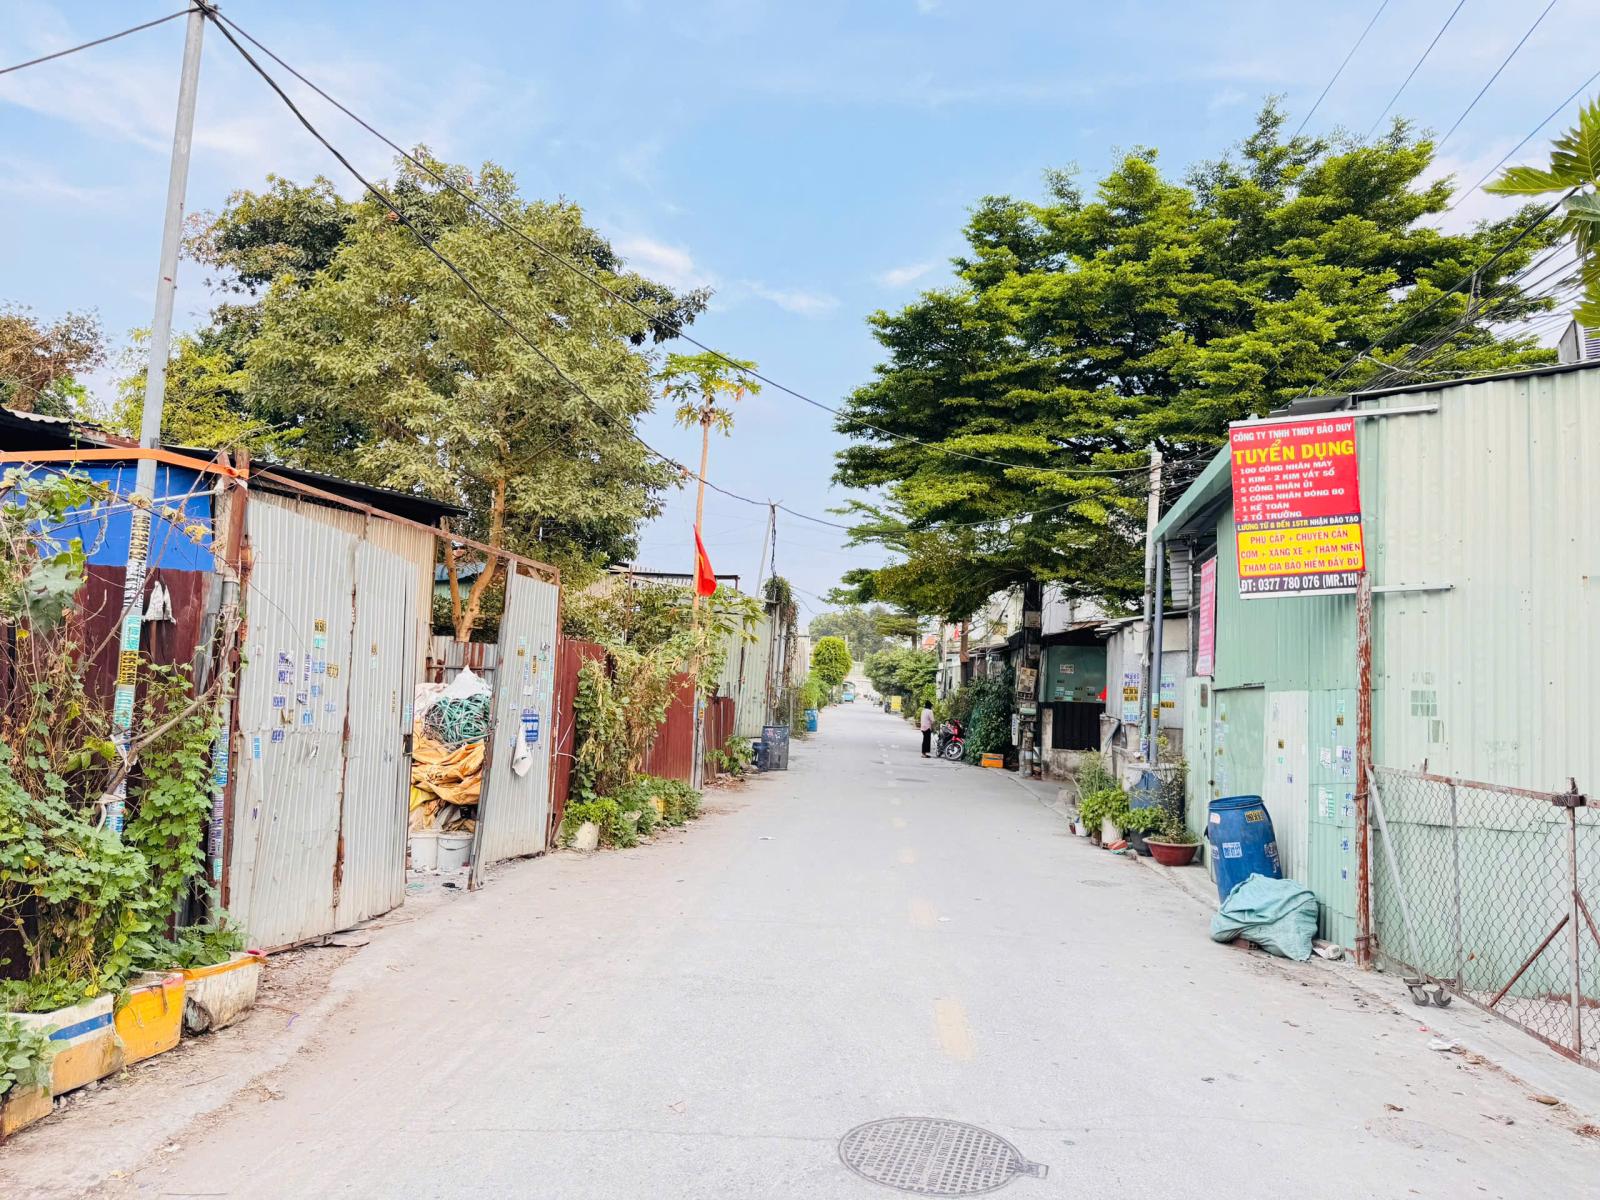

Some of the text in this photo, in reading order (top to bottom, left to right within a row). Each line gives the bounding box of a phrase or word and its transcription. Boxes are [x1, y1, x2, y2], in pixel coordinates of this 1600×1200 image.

[1233, 431, 1254, 442] CÔNG
[1256, 431, 1266, 439] TY
[1268, 430, 1290, 440] TNHH
[1292, 427, 1314, 437] TMDV
[1336, 423, 1352, 432] DUY
[1233, 439, 1354, 464] TUYỂN DỤNG
[1260, 464, 1283, 473] CÔNG
[1286, 462, 1310, 471] NHÂN
[1313, 460, 1332, 468] MAY
[1249, 484, 1272, 492] CÔNG
[1276, 482, 1300, 490] NHÂN
[1250, 494, 1274, 502] CÔNG
[1276, 492, 1301, 500] NHÂN
[1265, 502, 1290, 510] TOÁN
[1310, 518, 1328, 526] NHẬN
[1345, 516, 1358, 524] TẠO
[1293, 546, 1303, 555] XE
[1244, 562, 1266, 572] THAM
[1269, 562, 1282, 571] GIA
[1258, 577, 1280, 591] 0377
[1283, 576, 1300, 590] 780
[1302, 574, 1320, 588] 076
